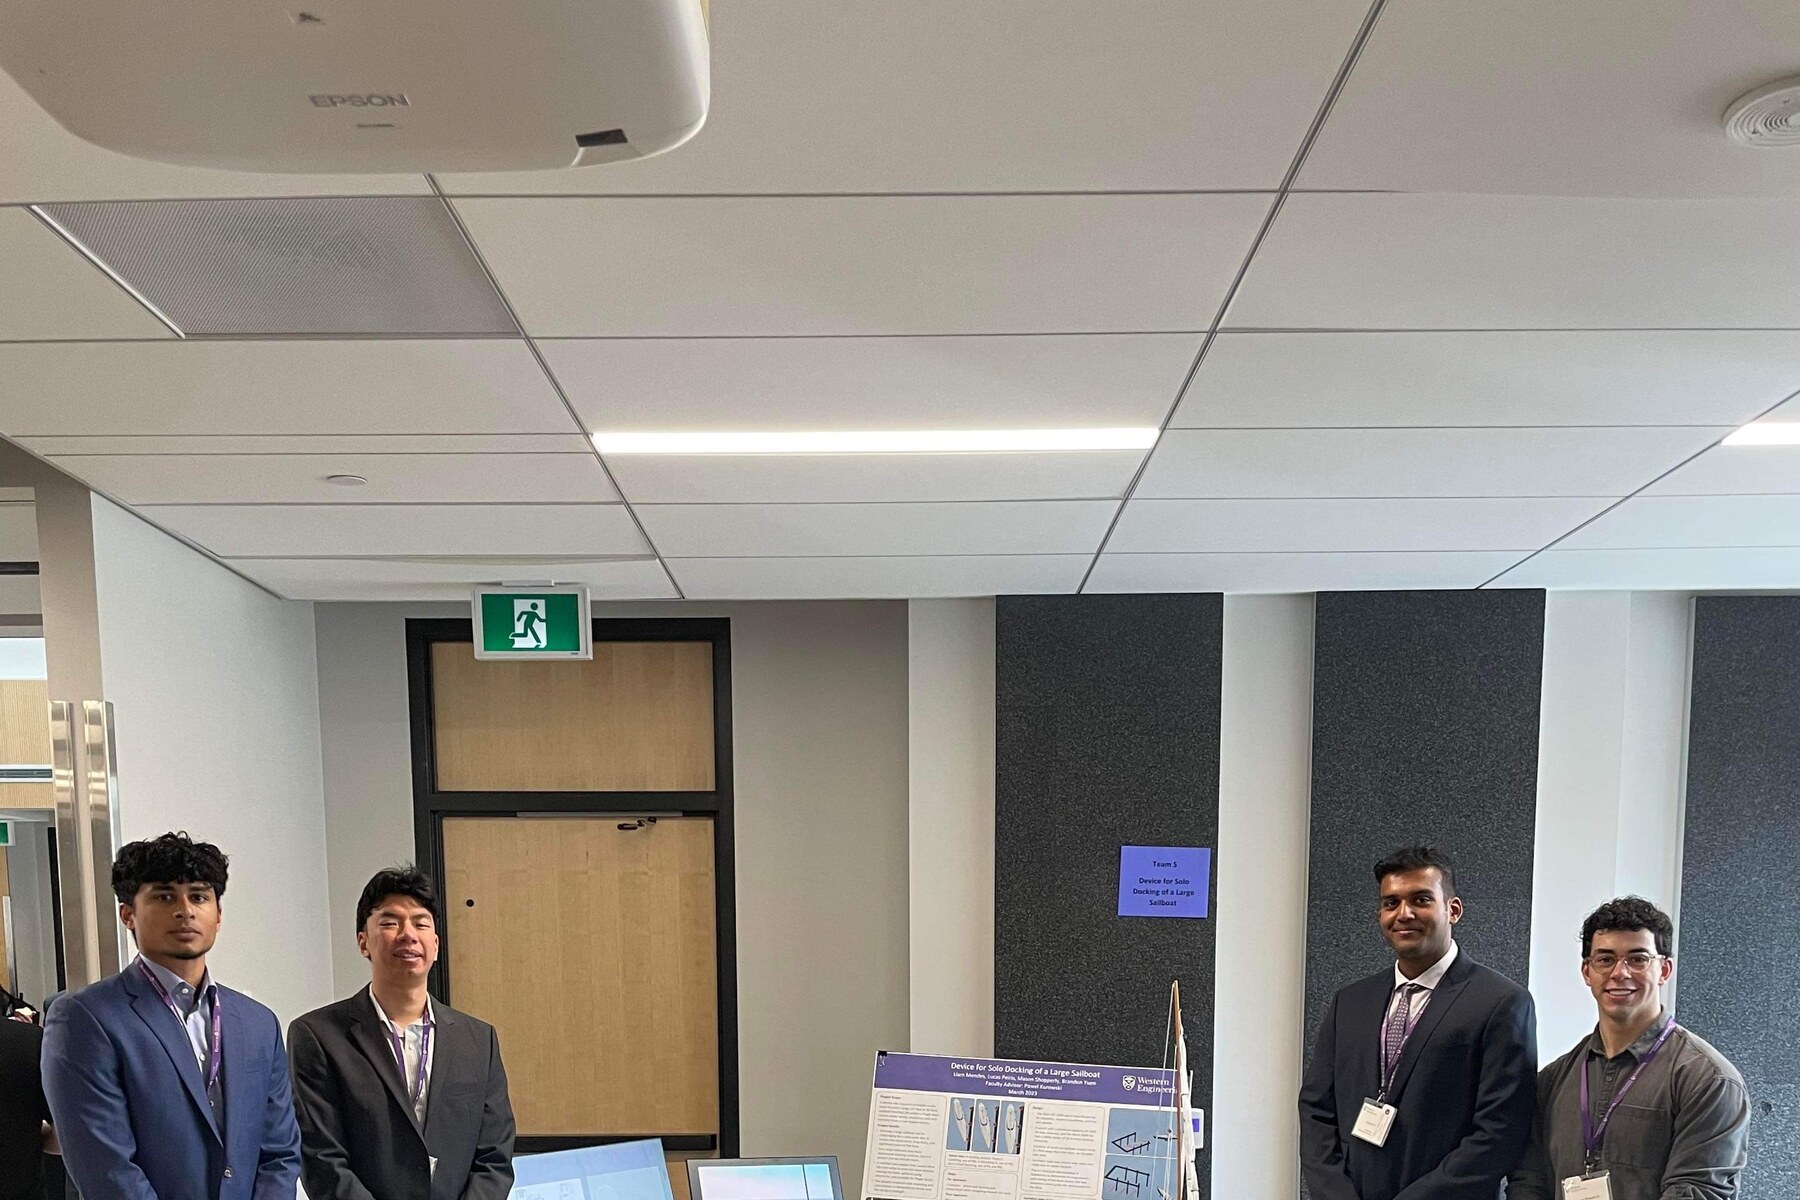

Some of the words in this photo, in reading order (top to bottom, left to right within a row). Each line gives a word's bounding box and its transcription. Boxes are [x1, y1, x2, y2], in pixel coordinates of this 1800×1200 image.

[308, 94, 411, 108] EPSON
[1152, 860, 1172, 868] Team
[1132, 888, 1160, 896] Docking
[1175, 889, 1195, 897] Large
[951, 1062, 975, 1070] Device
[975, 1063, 986, 1071] for
[987, 1064, 1004, 1072] Solo
[1004, 1065, 1034, 1075] Docking
[1034, 1067, 1043, 1075] of
[1049, 1068, 1070, 1077] Large
[1071, 1069, 1101, 1079] Sailboat
[1137, 1076, 1170, 1086] Western
